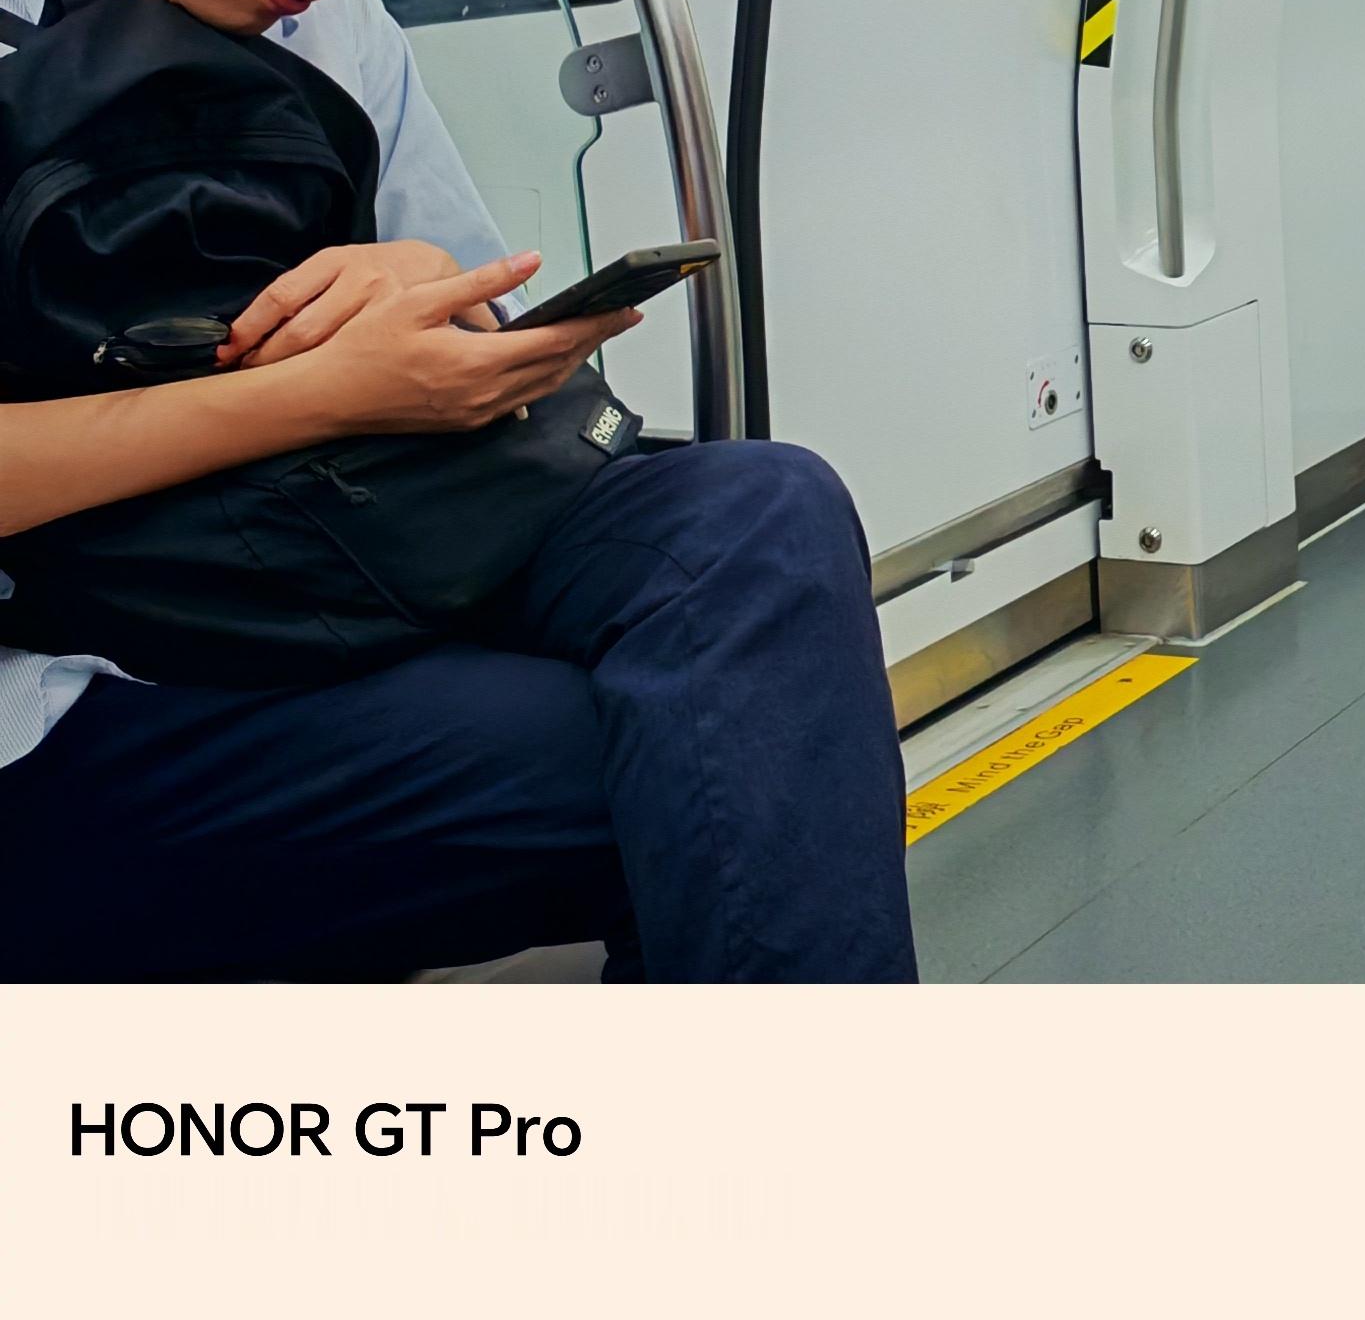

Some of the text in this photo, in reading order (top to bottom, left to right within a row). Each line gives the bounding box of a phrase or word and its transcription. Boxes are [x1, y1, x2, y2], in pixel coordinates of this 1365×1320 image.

[946, 715, 1085, 794] Mind the Gap
